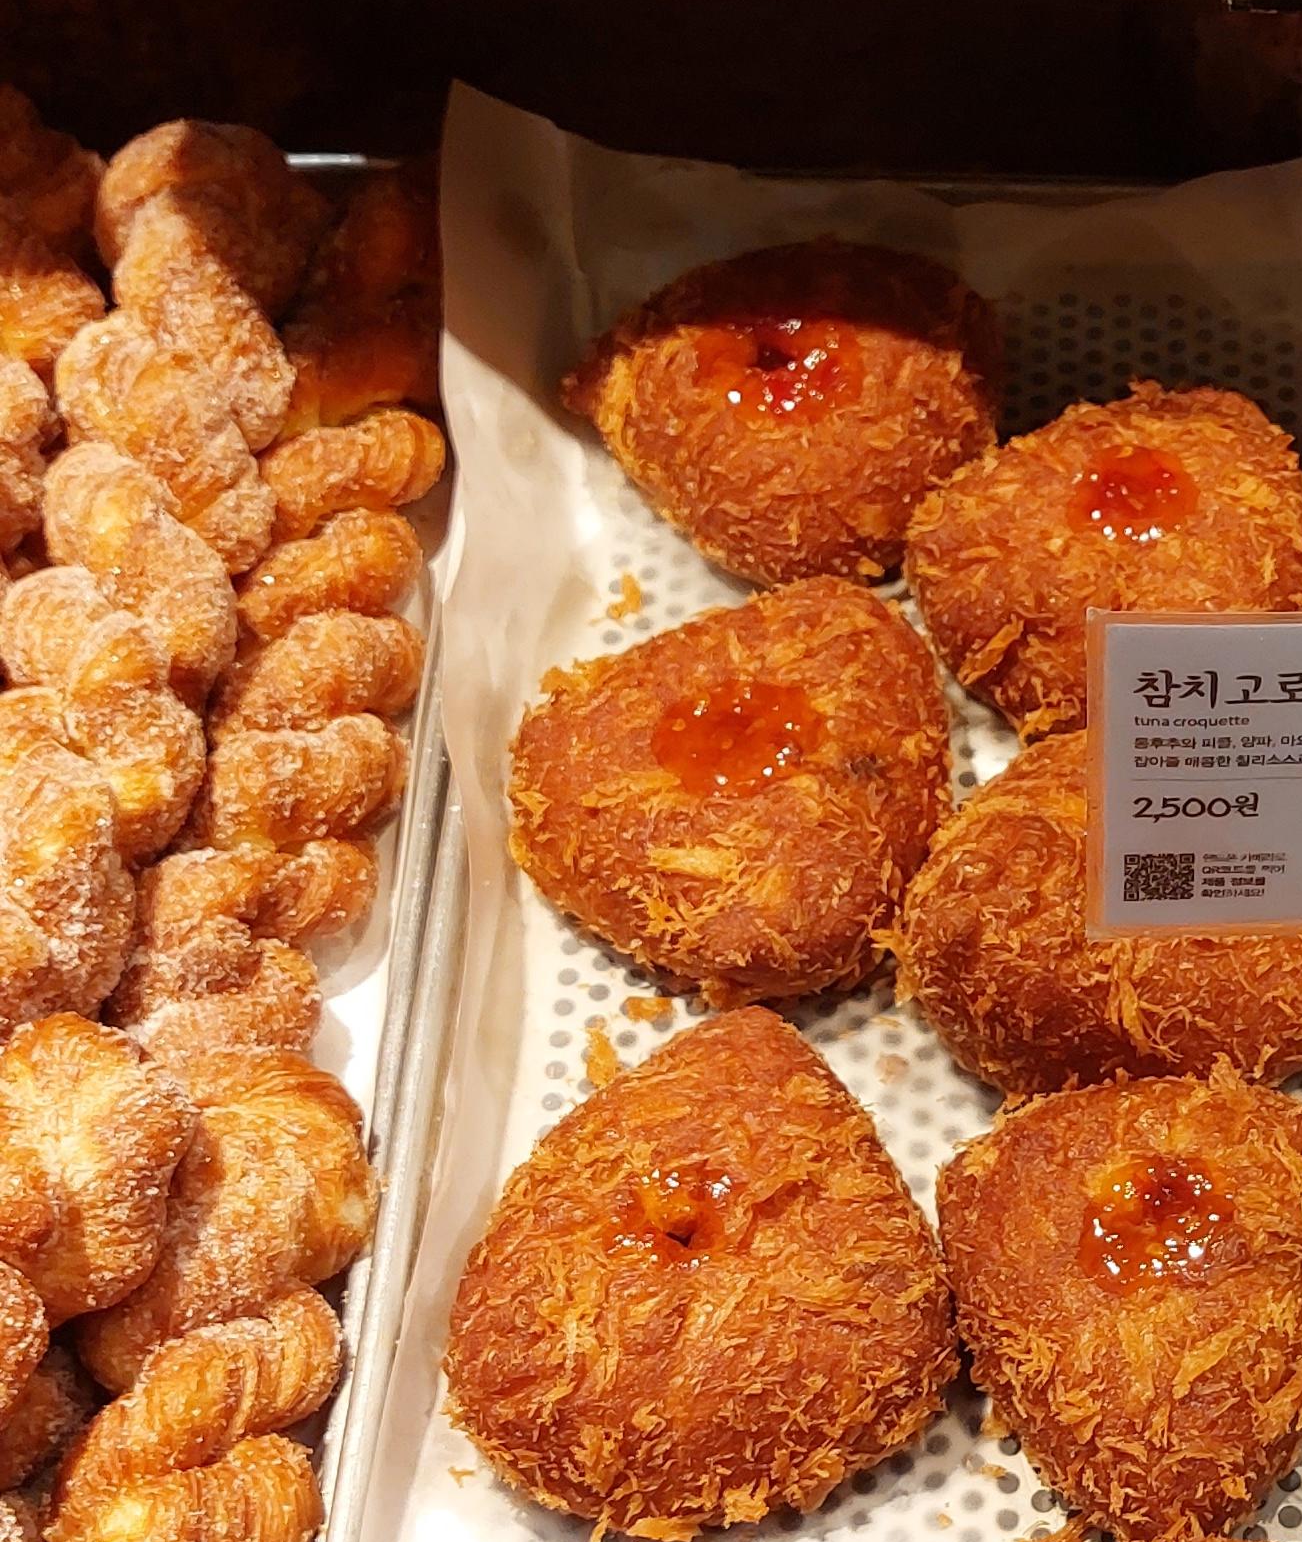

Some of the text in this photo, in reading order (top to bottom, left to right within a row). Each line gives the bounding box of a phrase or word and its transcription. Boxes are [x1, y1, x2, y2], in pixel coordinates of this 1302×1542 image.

[1134, 715, 1250, 730] tuna croquette
[1134, 736, 1197, 750] 통후추와
[1201, 736, 1237, 749] 피클,
[1240, 734, 1276, 749] 양파,
[1184, 755, 1231, 768] 매콤한
[1132, 792, 1259, 823] 2,500원
[1202, 864, 1256, 874] QR코드를
[1201, 877, 1266, 887] 제품 정보를
